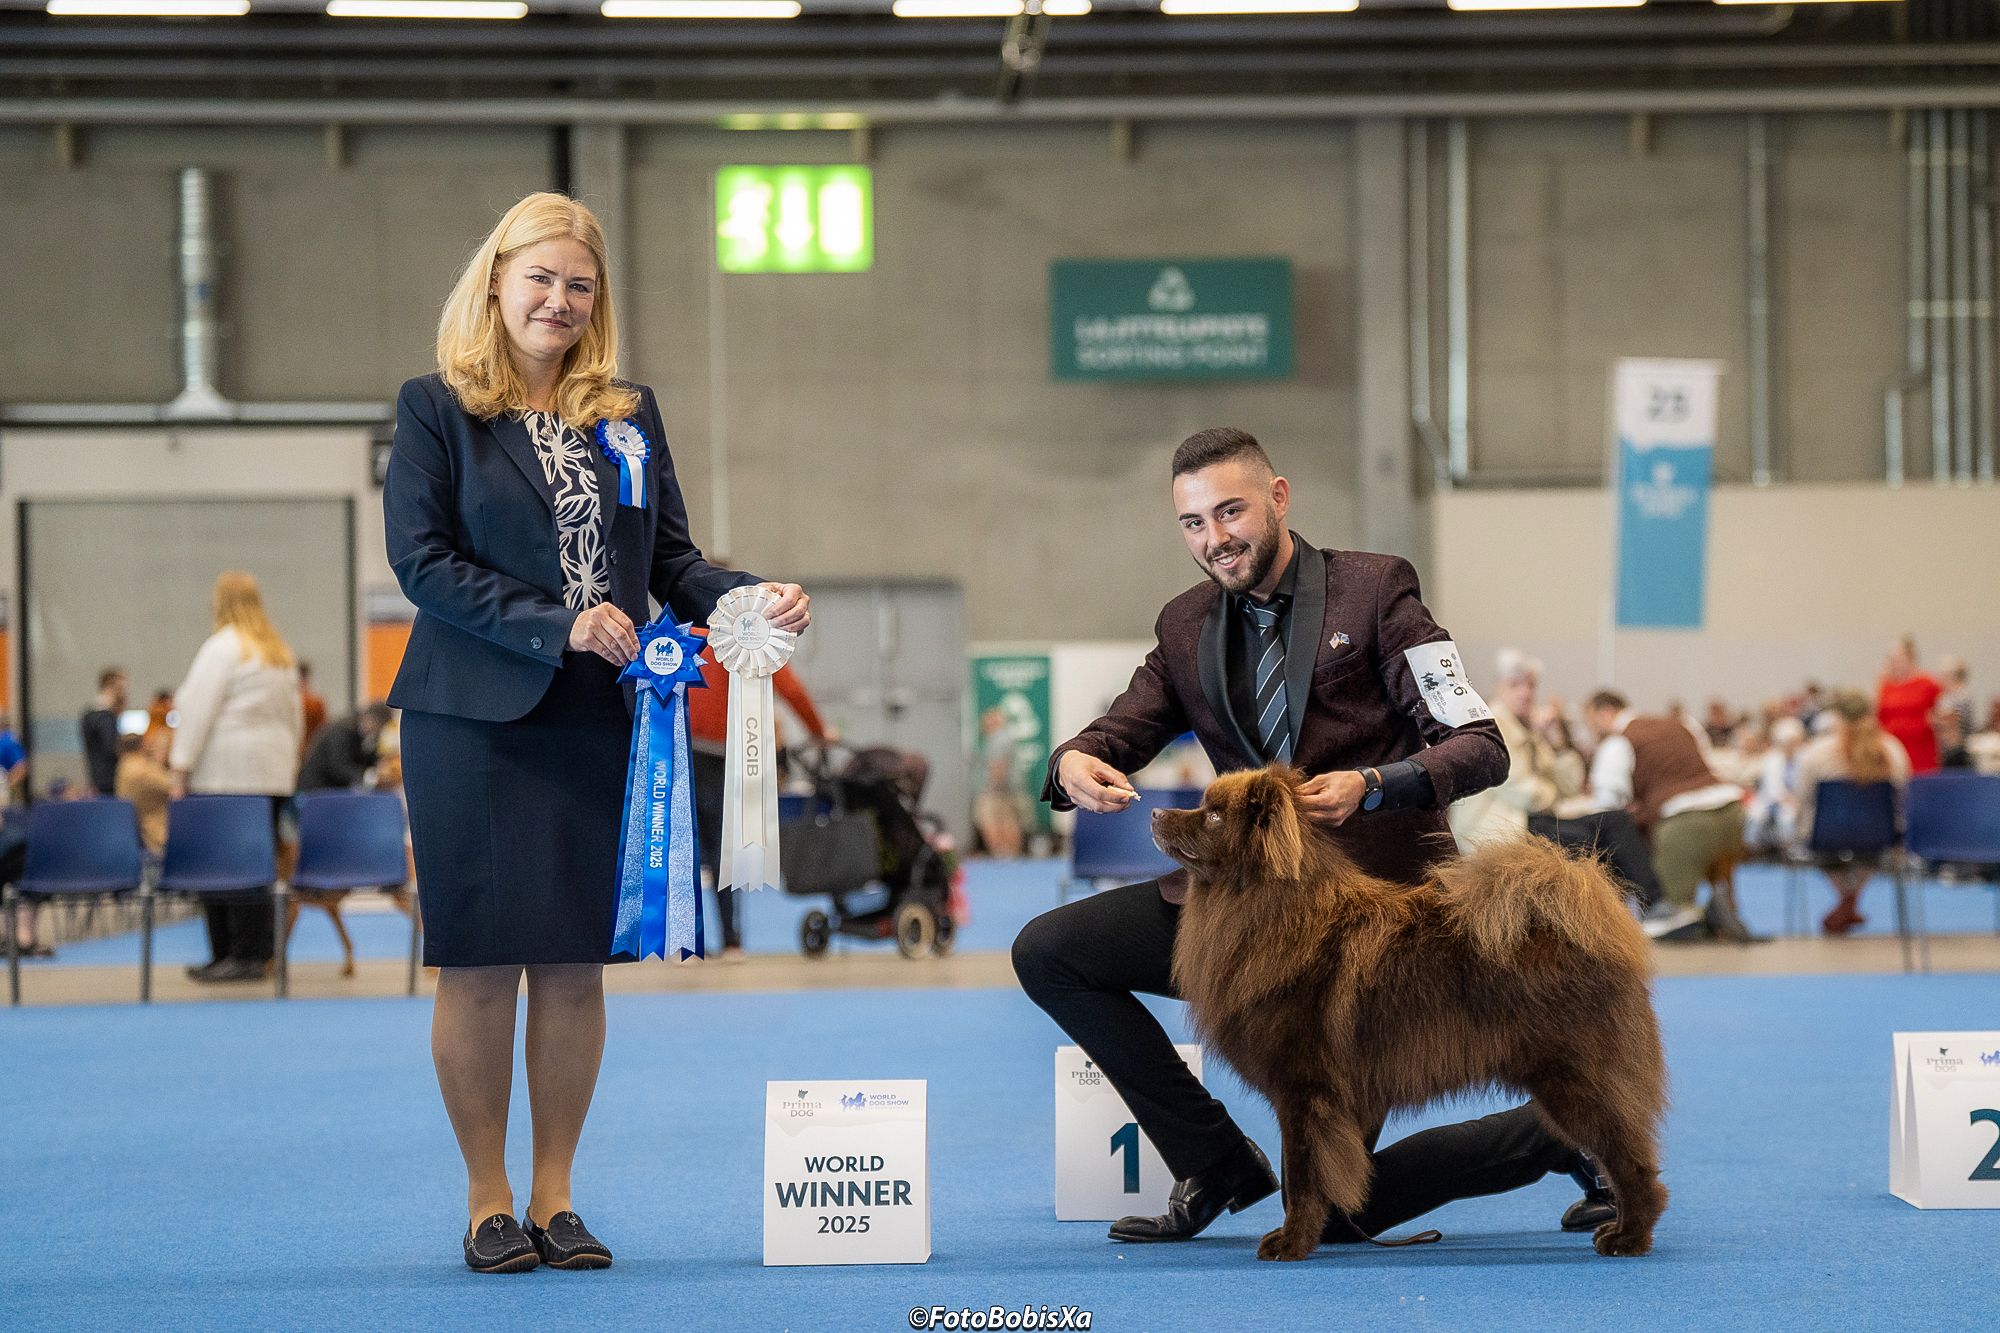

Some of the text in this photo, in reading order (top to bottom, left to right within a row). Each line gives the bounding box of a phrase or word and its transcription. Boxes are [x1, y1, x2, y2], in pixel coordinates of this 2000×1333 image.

[1440, 658, 1468, 696] 816
[745, 716, 759, 778] CACIB
[649, 760, 667, 869] WORLD WINNER 2025
[1078, 1078, 1101, 1086] DOG
[790, 1109, 814, 1117] DOG
[1110, 1122, 1140, 1194] 1
[1968, 1108, 2000, 1181] 2
[804, 1155, 884, 1174] WORLD
[774, 1180, 913, 1209] WINNER
[817, 1215, 871, 1234] 2025
